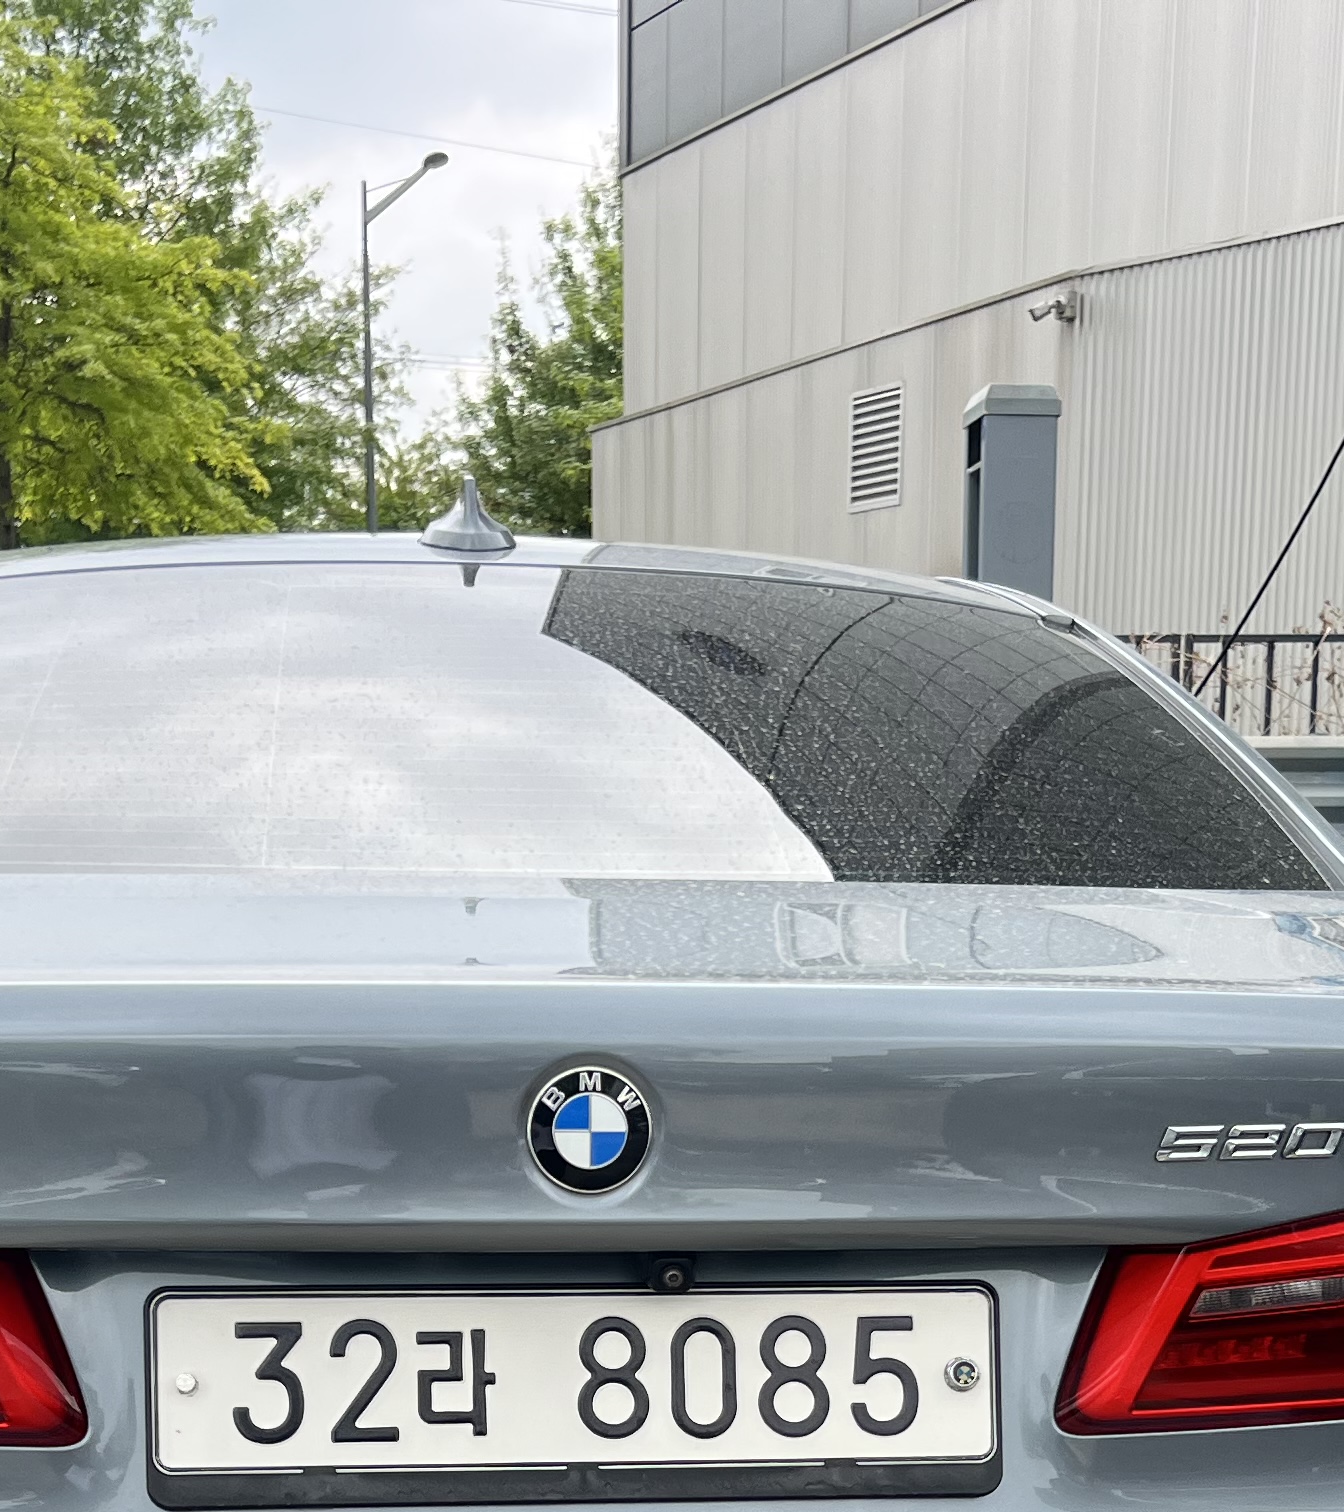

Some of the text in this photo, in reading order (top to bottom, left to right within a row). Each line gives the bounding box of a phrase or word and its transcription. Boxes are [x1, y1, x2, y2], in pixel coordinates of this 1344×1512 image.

[541, 1071, 642, 1112] BMW
[232, 1315, 920, 1445] 32라 8085
